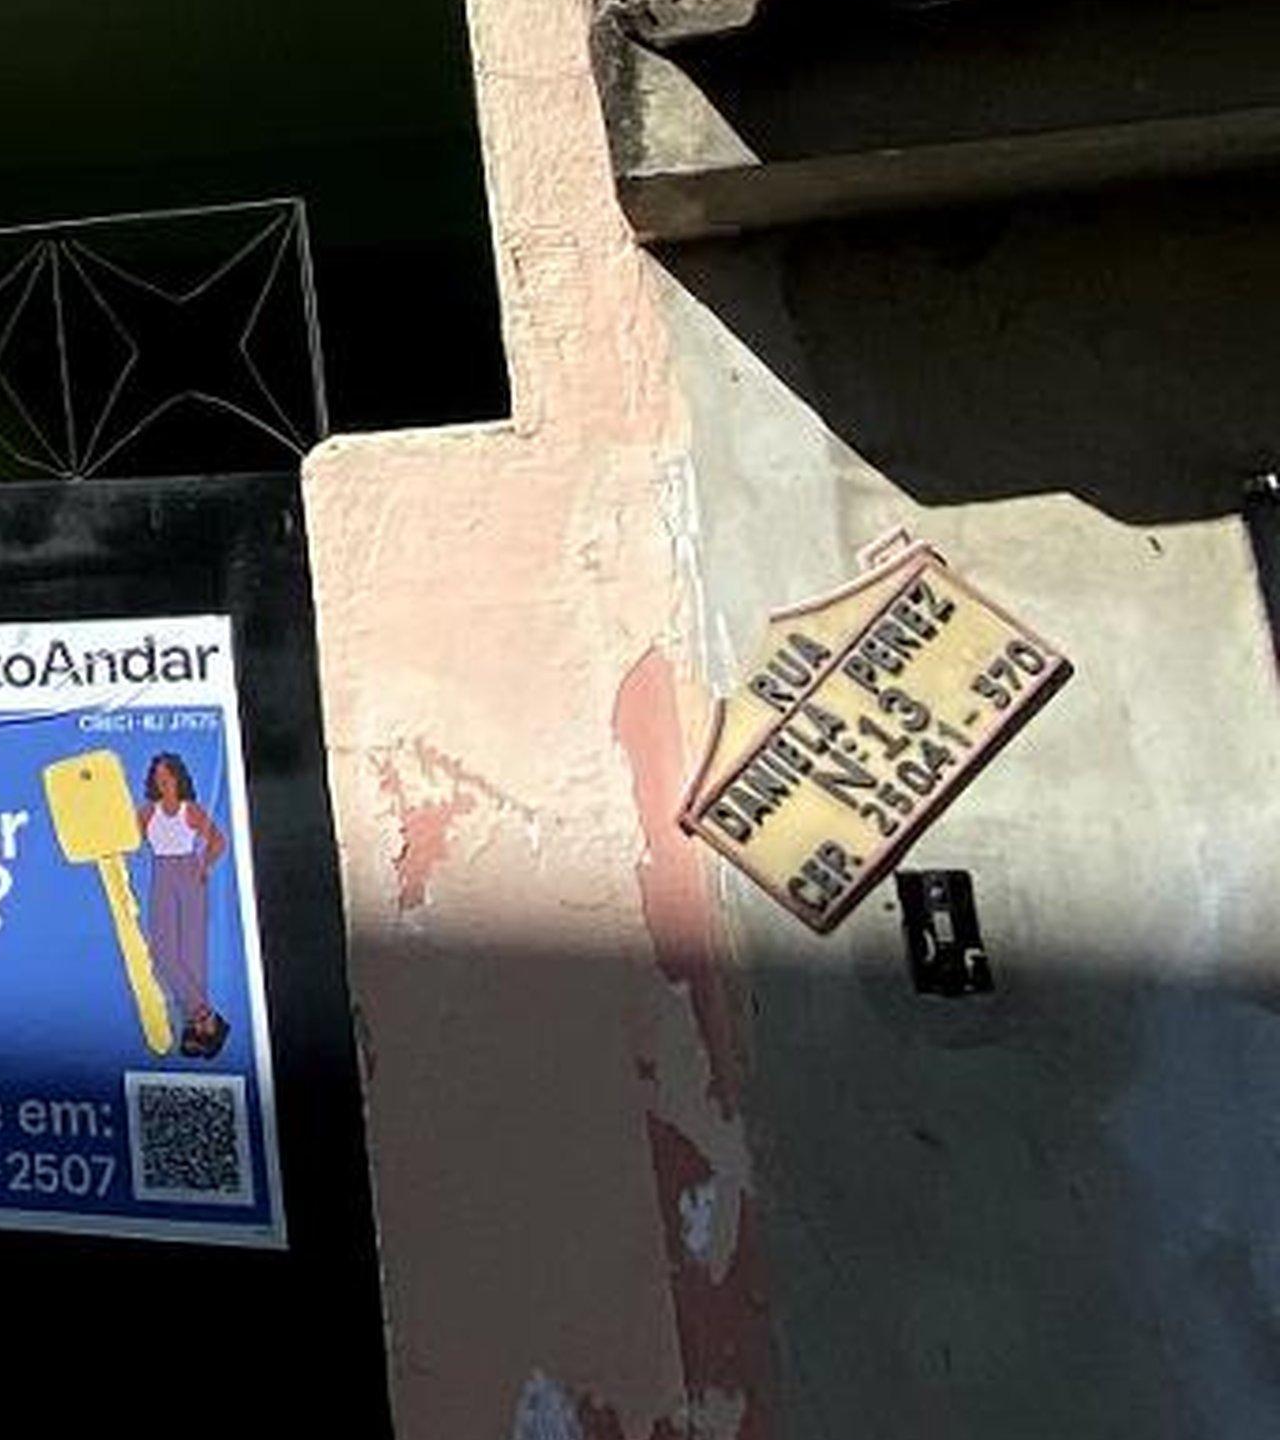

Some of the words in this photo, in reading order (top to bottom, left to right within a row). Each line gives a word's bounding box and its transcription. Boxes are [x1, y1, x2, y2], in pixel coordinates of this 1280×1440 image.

[705, 702, 847, 844] DANIELA
[842, 581, 956, 693] PEREZ
[749, 633, 831, 713] RUA
[18, 1099, 112, 1138] em:
